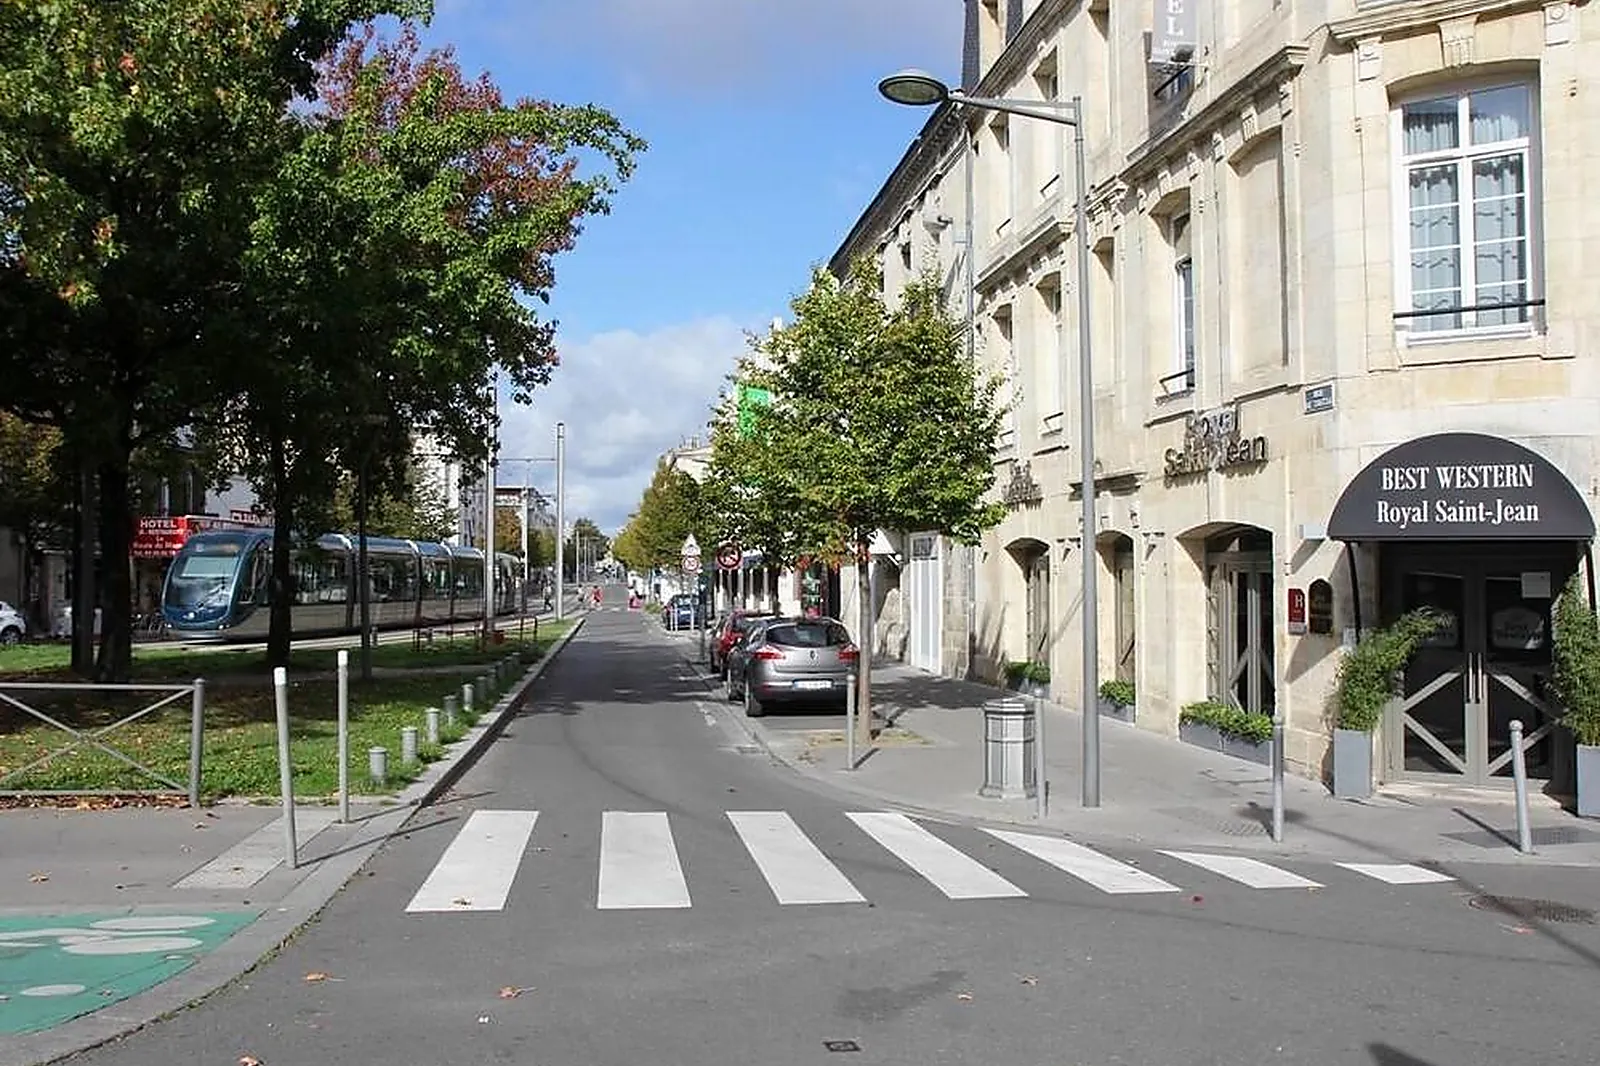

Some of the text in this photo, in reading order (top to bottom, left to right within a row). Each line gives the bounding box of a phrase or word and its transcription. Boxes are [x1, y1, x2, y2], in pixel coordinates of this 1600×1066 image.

[1381, 464, 1533, 490] BEST WESTERN
[140, 519, 177, 528] HOTEL
[1377, 498, 1539, 529] Royal Saint-Jean
